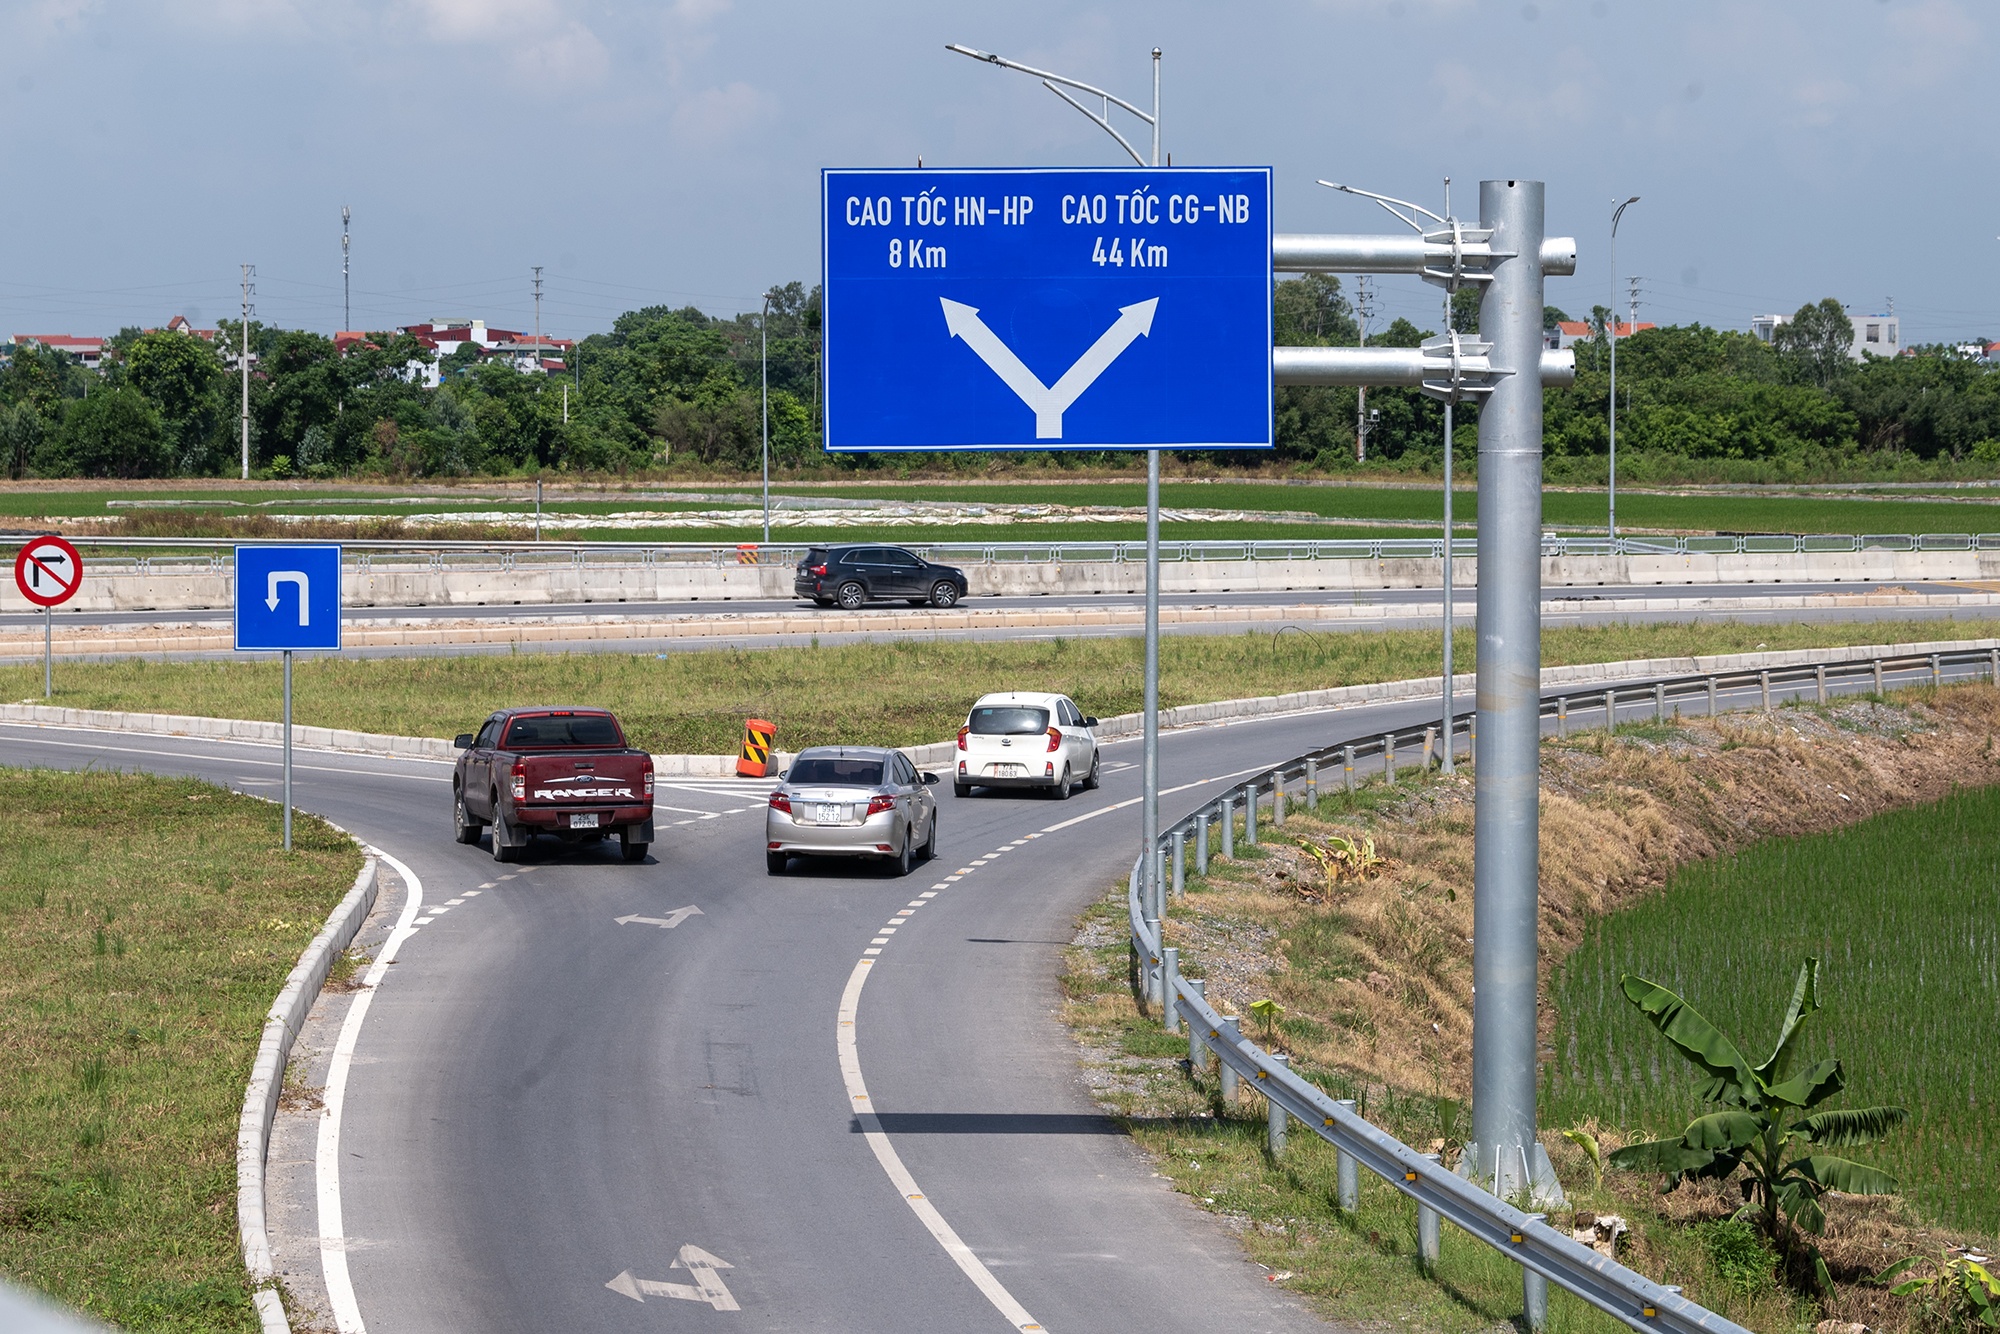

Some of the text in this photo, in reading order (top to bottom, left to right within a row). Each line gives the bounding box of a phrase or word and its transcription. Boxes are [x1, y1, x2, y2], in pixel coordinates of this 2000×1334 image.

[846, 186, 1034, 226] CAO TỐC HN-HP
[1061, 184, 1250, 225] CAO TỐC CG-NB
[889, 238, 946, 268] 8 Km
[1092, 236, 1168, 268] 44 Km
[534, 788, 635, 801] RANGER
[573, 820, 595, 828] 07204
[818, 813, 840, 821] 15212
